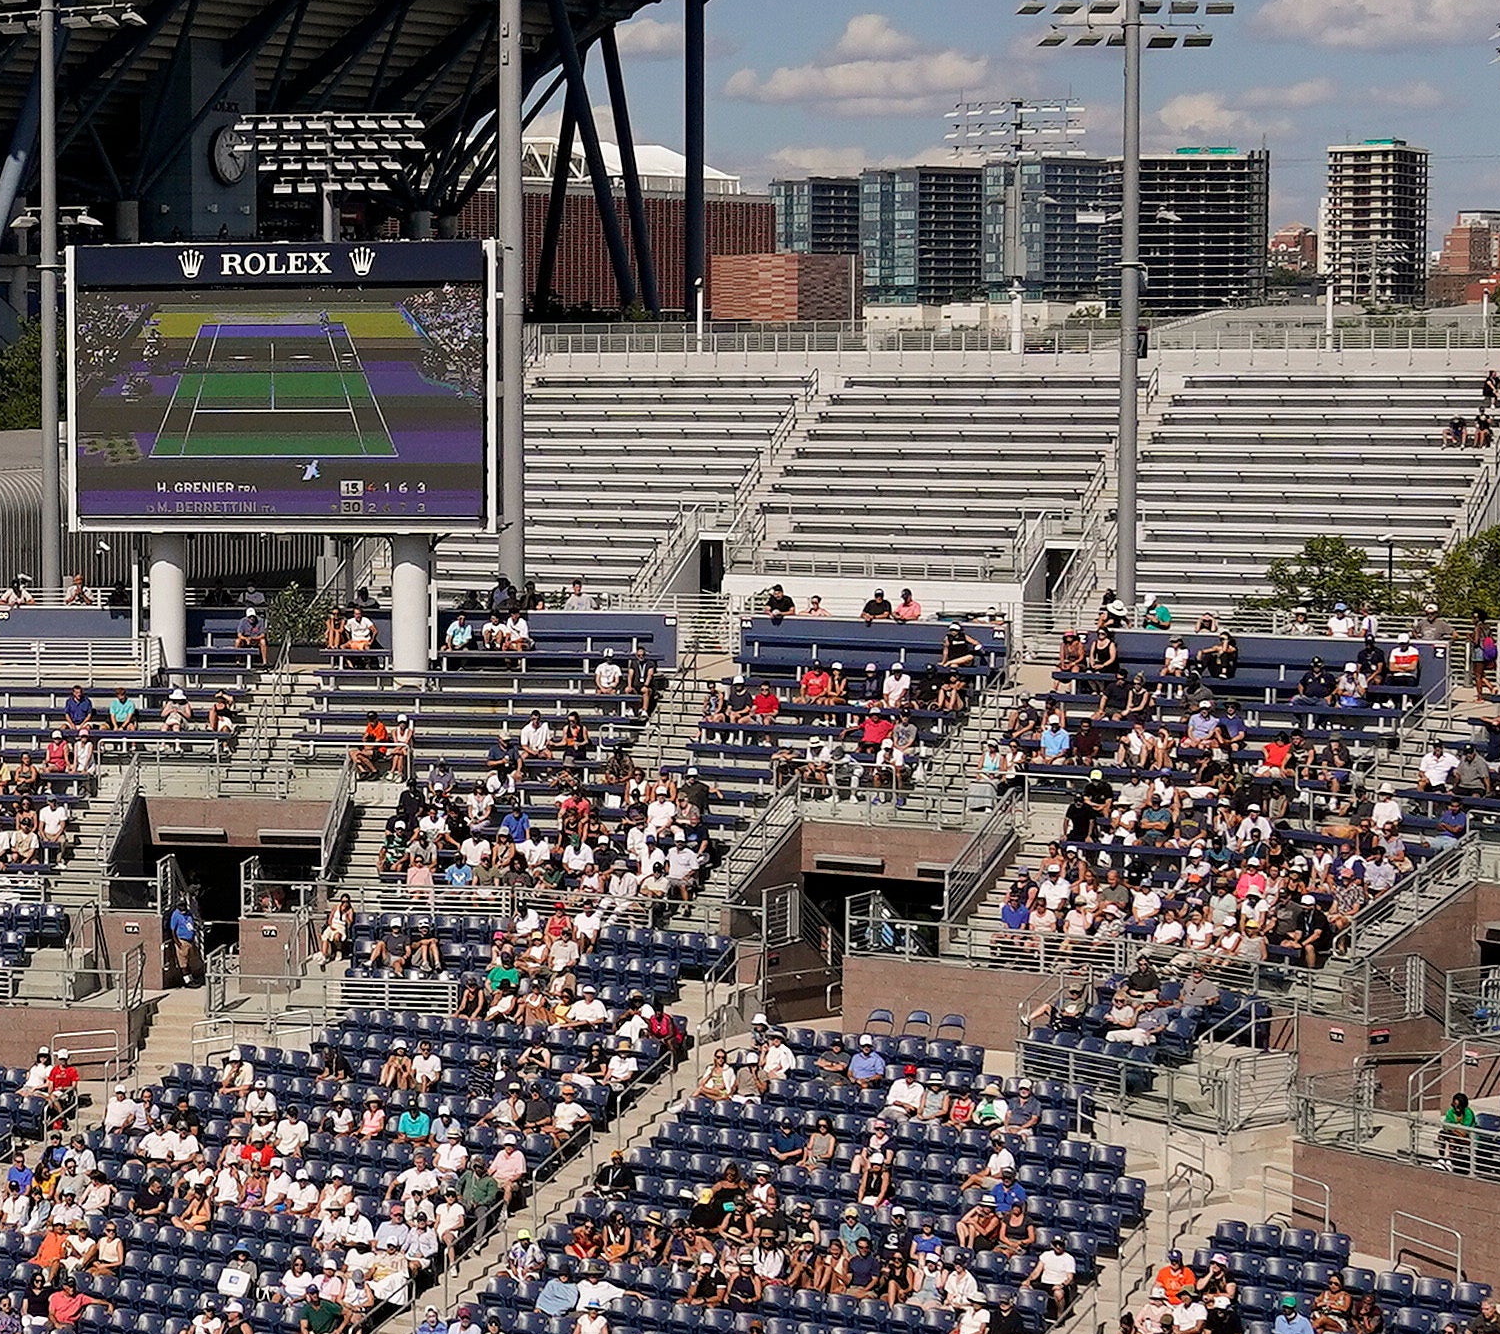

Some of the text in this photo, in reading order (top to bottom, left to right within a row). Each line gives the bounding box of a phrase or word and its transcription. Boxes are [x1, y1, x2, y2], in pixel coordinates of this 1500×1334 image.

[220, 252, 333, 275] ROLEX
[174, 481, 234, 493] GRENIER
[384, 482, 391, 493] 1
[398, 482, 408, 493] 6
[417, 482, 426, 493] 3
[176, 501, 257, 513] BERRETTINI
[368, 503, 377, 513] 2
[417, 503, 426, 513] 3
